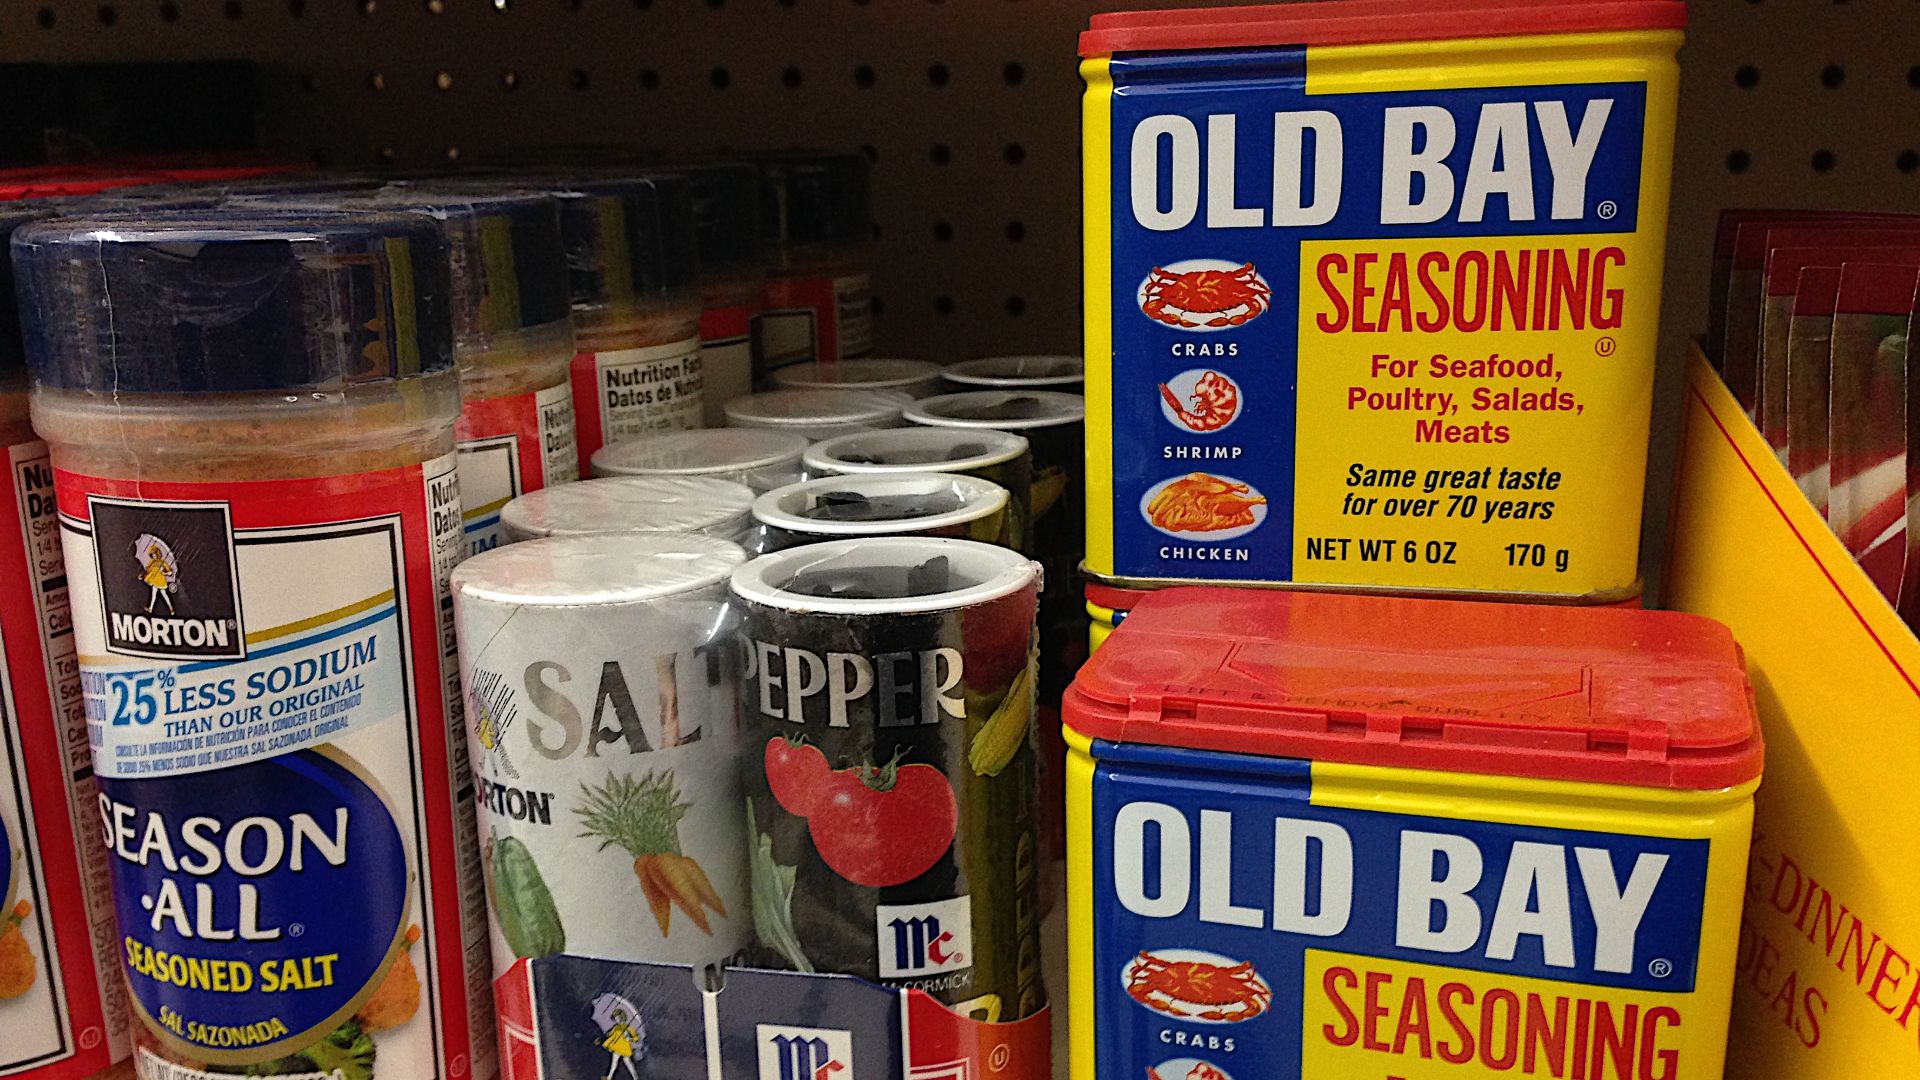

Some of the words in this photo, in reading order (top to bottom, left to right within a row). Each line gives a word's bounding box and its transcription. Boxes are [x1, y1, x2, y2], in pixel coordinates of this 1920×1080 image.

[1130, 108, 1343, 232] OLD
[1379, 98, 1615, 225] BAY
[1316, 247, 1626, 334] SEASONING
[1171, 343, 1239, 357] CRABS
[606, 363, 680, 388] Nutrition
[1370, 354, 1417, 378] For
[1428, 354, 1562, 383] Seafood,
[608, 388, 652, 408] Datos
[657, 383, 671, 402] de
[1347, 386, 1459, 416] Poultry,
[1471, 386, 1585, 416] Salads,
[1415, 419, 1511, 444] Meats
[1163, 445, 1243, 460] SHRIMP
[1346, 463, 1417, 488] Same
[1423, 467, 1492, 493] great
[1497, 467, 1562, 490] taste
[1342, 492, 1378, 516] for
[1383, 498, 1440, 517] over
[1446, 495, 1478, 518] 70
[1482, 500, 1556, 524] years
[1159, 546, 1250, 562] CHICKEN
[1306, 537, 1351, 561] NET
[1359, 539, 1397, 562] WT
[1403, 540, 1417, 563] 6
[1425, 541, 1458, 564] OZ
[1504, 543, 1546, 567] 170
[1555, 549, 1569, 573] g
[111, 612, 229, 648] MORTON
[163, 679, 236, 716] LESS
[245, 634, 378, 701] SODIUM
[736, 633, 968, 728] PEPPER
[163, 715, 214, 738] THAN
[219, 705, 263, 729] OUR
[268, 673, 365, 717] ORIGINAL
[523, 641, 736, 761] SALT
[247, 721, 270, 739] PARA
[309, 709, 318, 722] EL
[98, 792, 349, 876] SEASON
[1113, 801, 1353, 938] OLD
[1394, 829, 1670, 975] BAY
[125, 936, 253, 993] SEASONED
[259, 953, 339, 992] SALT
[159, 1004, 185, 1036] SAL
[187, 1016, 289, 1047] SAZONADA
[1159, 1028, 1236, 1053] CRABS
[1321, 965, 1682, 1080] SEASONING
